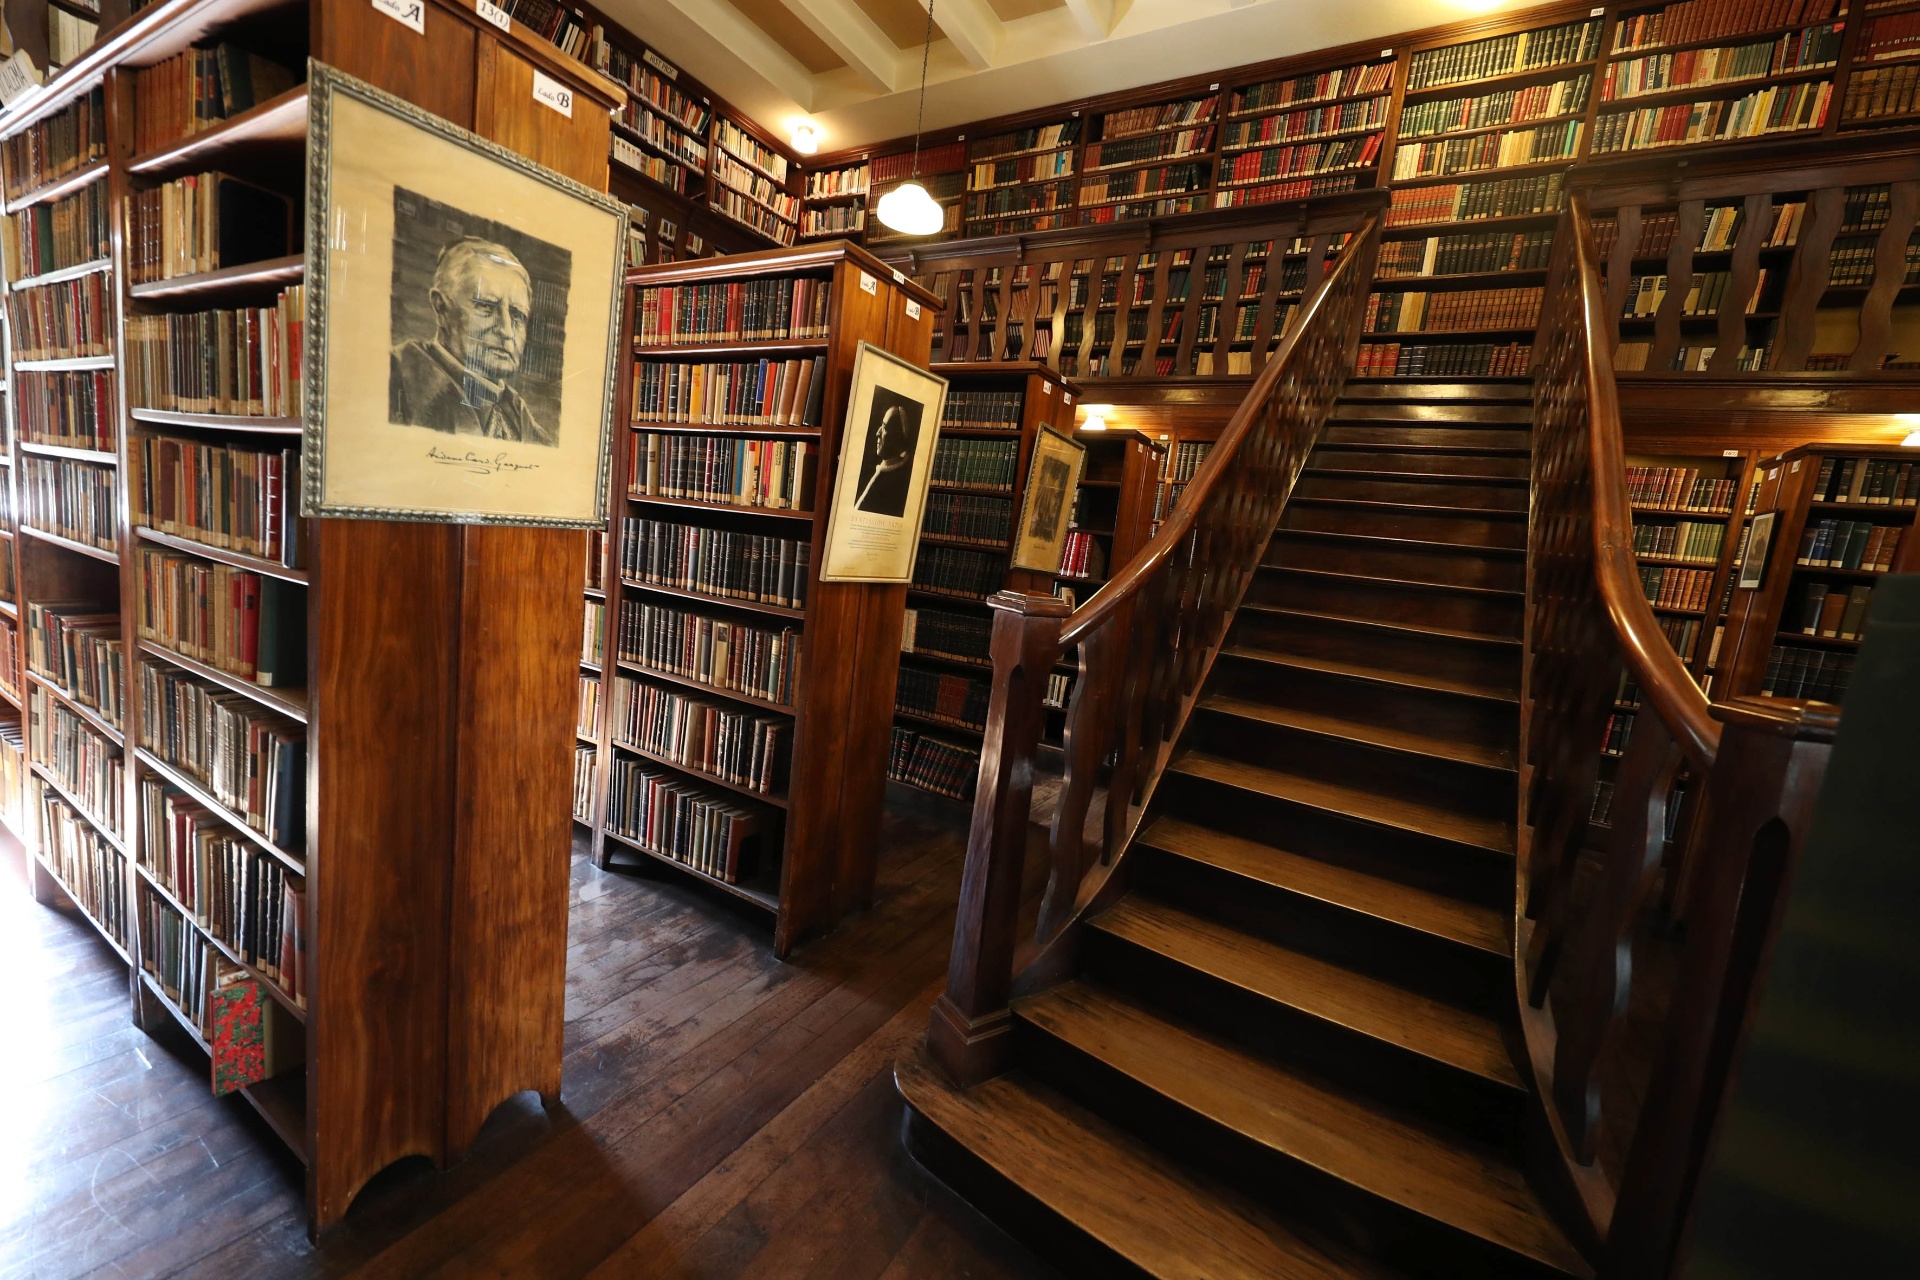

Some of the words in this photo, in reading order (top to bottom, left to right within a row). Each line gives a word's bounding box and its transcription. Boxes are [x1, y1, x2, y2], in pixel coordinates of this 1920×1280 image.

[377, 0, 400, 11] ado
[401, 3, 421, 24] A
[556, 92, 570, 108] B
